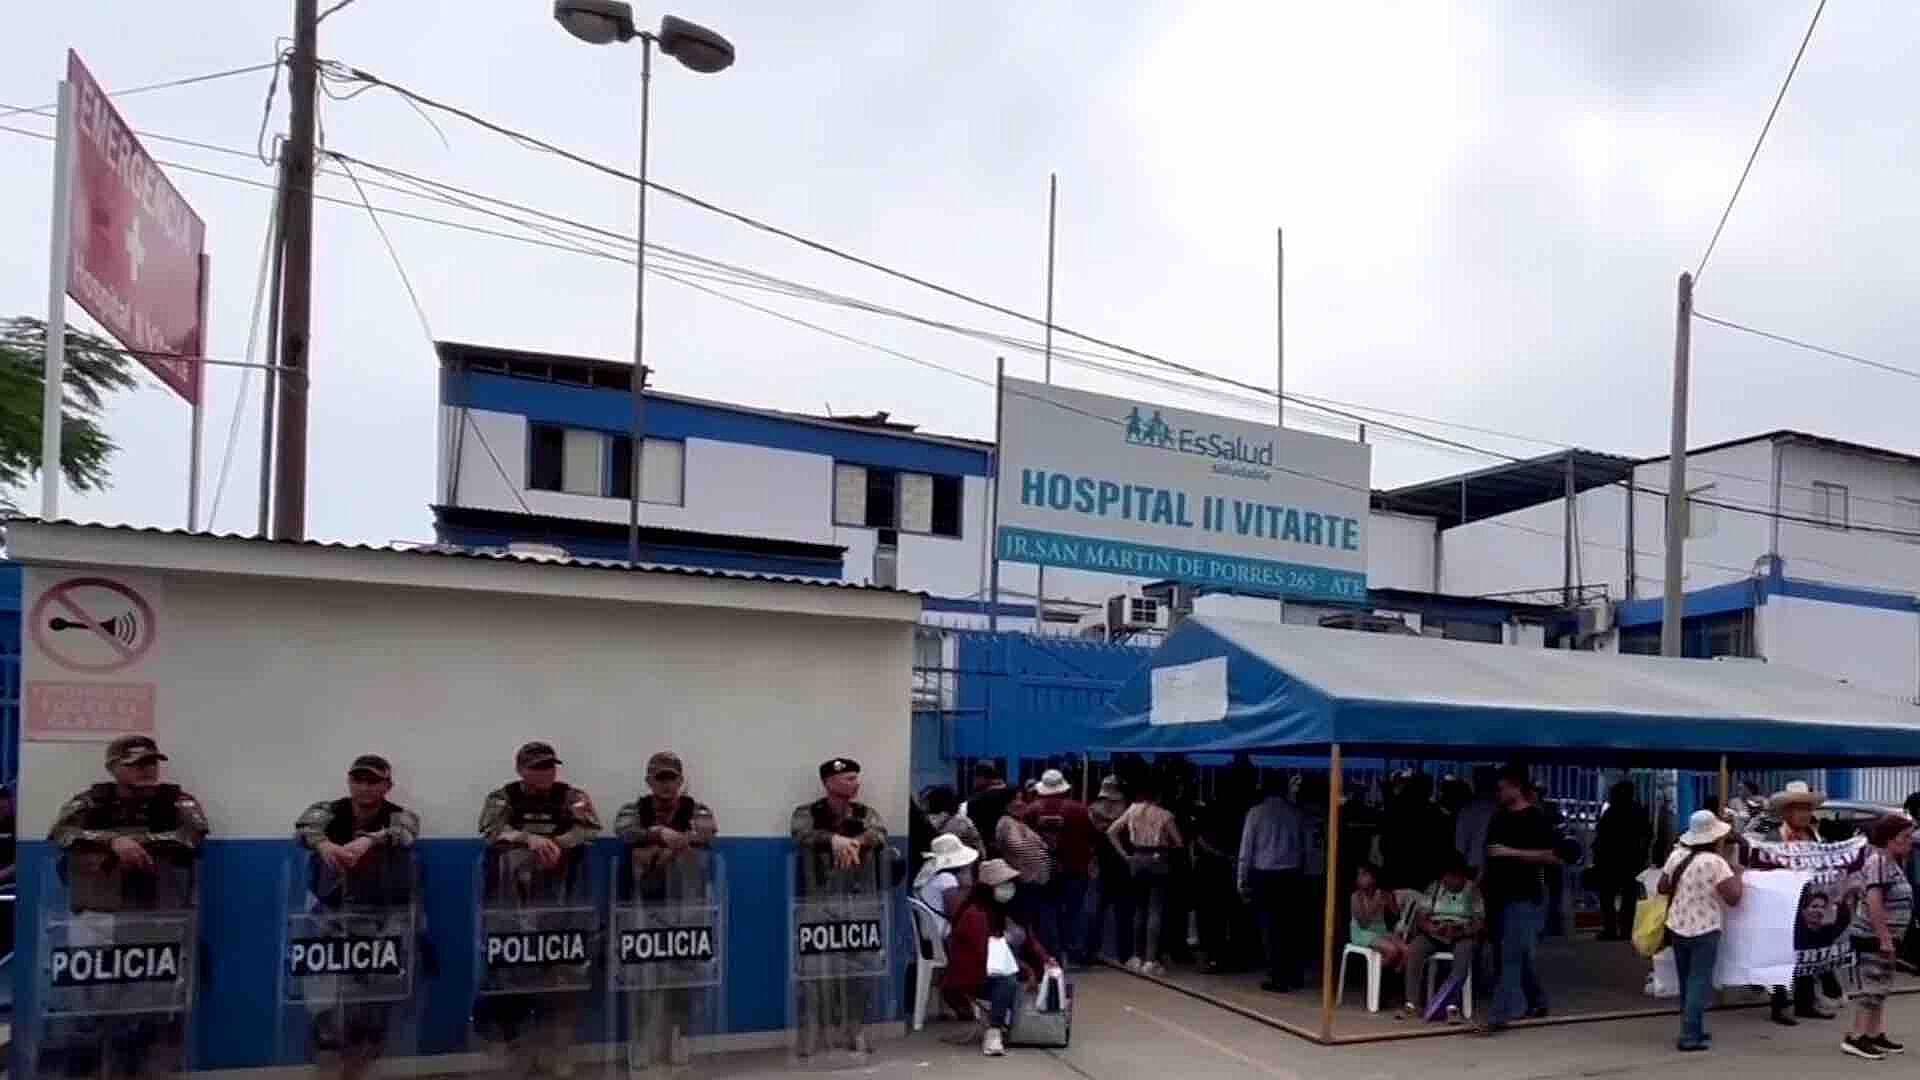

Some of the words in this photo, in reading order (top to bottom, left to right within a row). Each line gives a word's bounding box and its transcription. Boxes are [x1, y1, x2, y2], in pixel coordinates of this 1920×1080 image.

[1179, 429, 1273, 466] EsSalud
[1021, 468, 1194, 528] HOSPITAL
[1202, 495, 1224, 533] II
[1233, 500, 1361, 551] VITARTE
[1085, 546, 1170, 573] MARTIN
[1175, 555, 1206, 577] DE
[1208, 559, 1283, 585] PORRES
[487, 933, 585, 964] POLICIA
[620, 930, 713, 959] POLICIA
[799, 922, 881, 952] POLICIA
[52, 947, 177, 982] POLICIA
[290, 939, 399, 972] POLICIA
